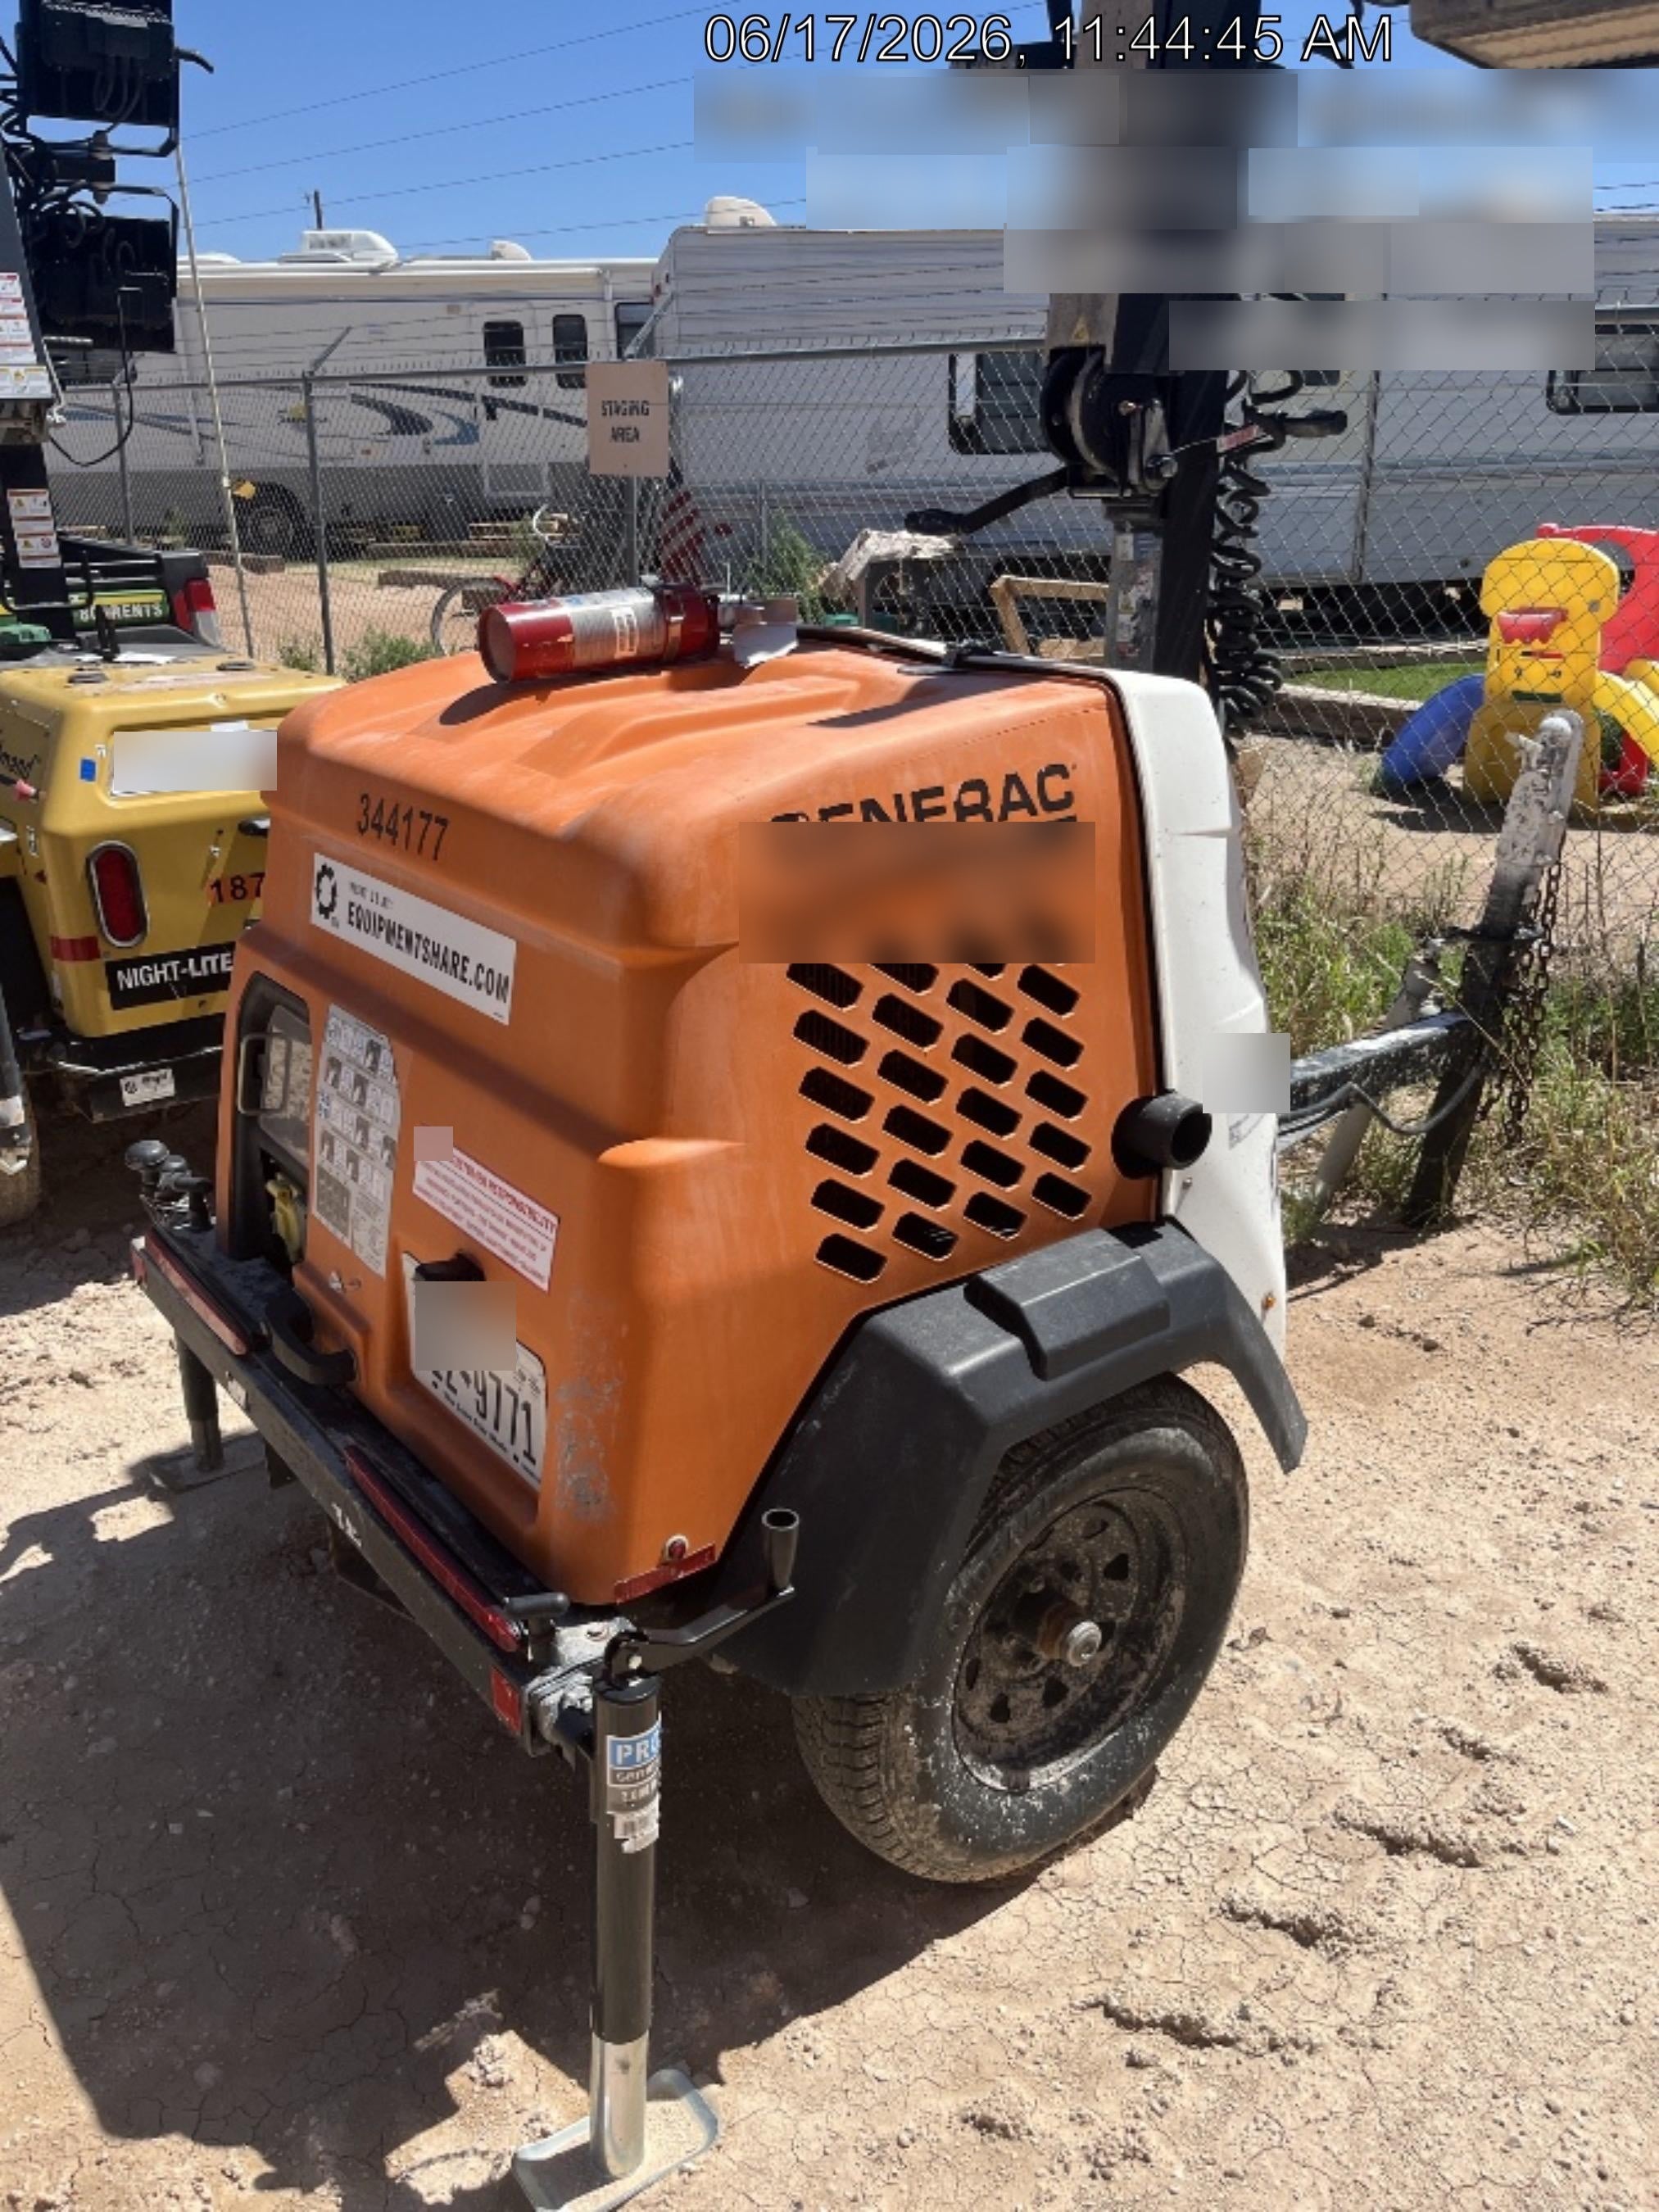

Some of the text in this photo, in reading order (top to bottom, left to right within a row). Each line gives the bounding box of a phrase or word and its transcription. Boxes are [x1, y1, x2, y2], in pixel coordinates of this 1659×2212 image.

[601, 399, 650, 417] STAGING
[610, 426, 640, 443] AREA
[771, 763, 1075, 822] NERAC
[356, 793, 449, 862] 344177
[210, 872, 266, 904] 187
[116, 952, 233, 991] NIGHT-LITE
[347, 900, 510, 1004] EQUIPMENTSHARE.COM
